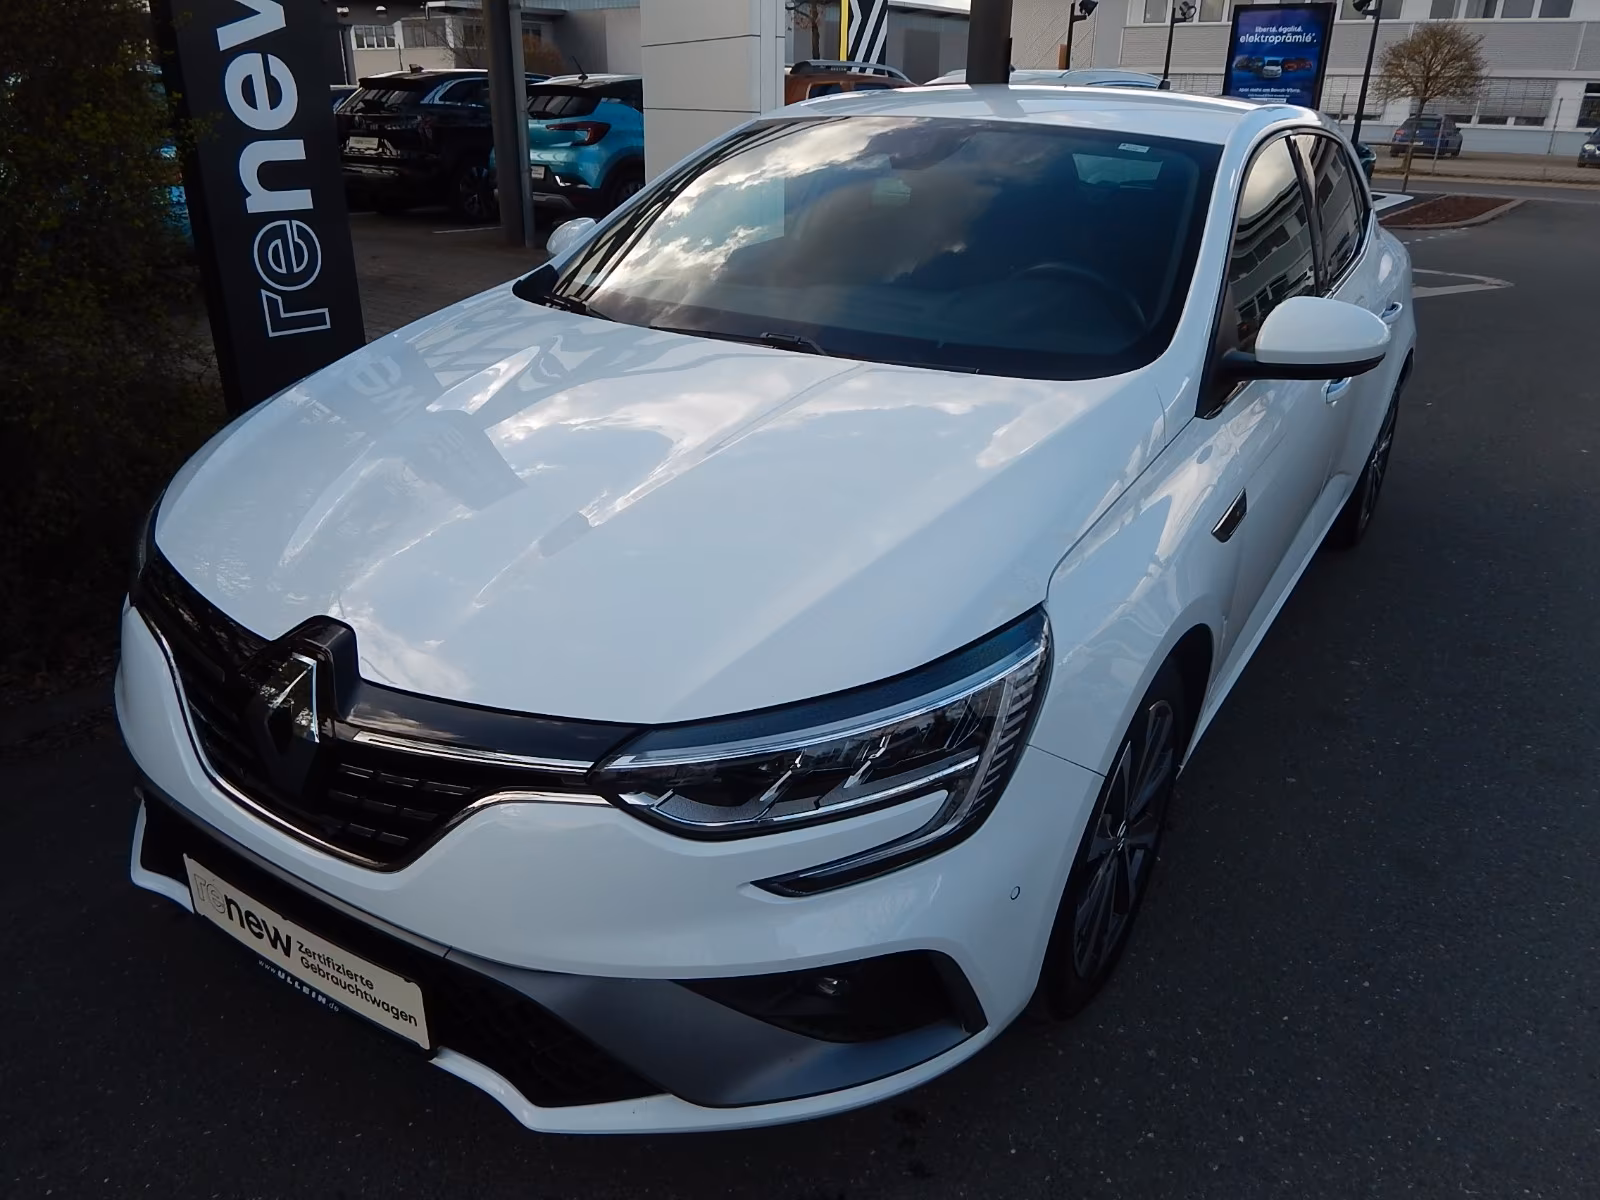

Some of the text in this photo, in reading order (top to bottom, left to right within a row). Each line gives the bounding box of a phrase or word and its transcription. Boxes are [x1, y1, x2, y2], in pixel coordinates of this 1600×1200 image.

[193, 873, 291, 958] renew
[296, 940, 374, 990] Zertifizierte
[300, 956, 418, 1027] Gebrauchtwagen
